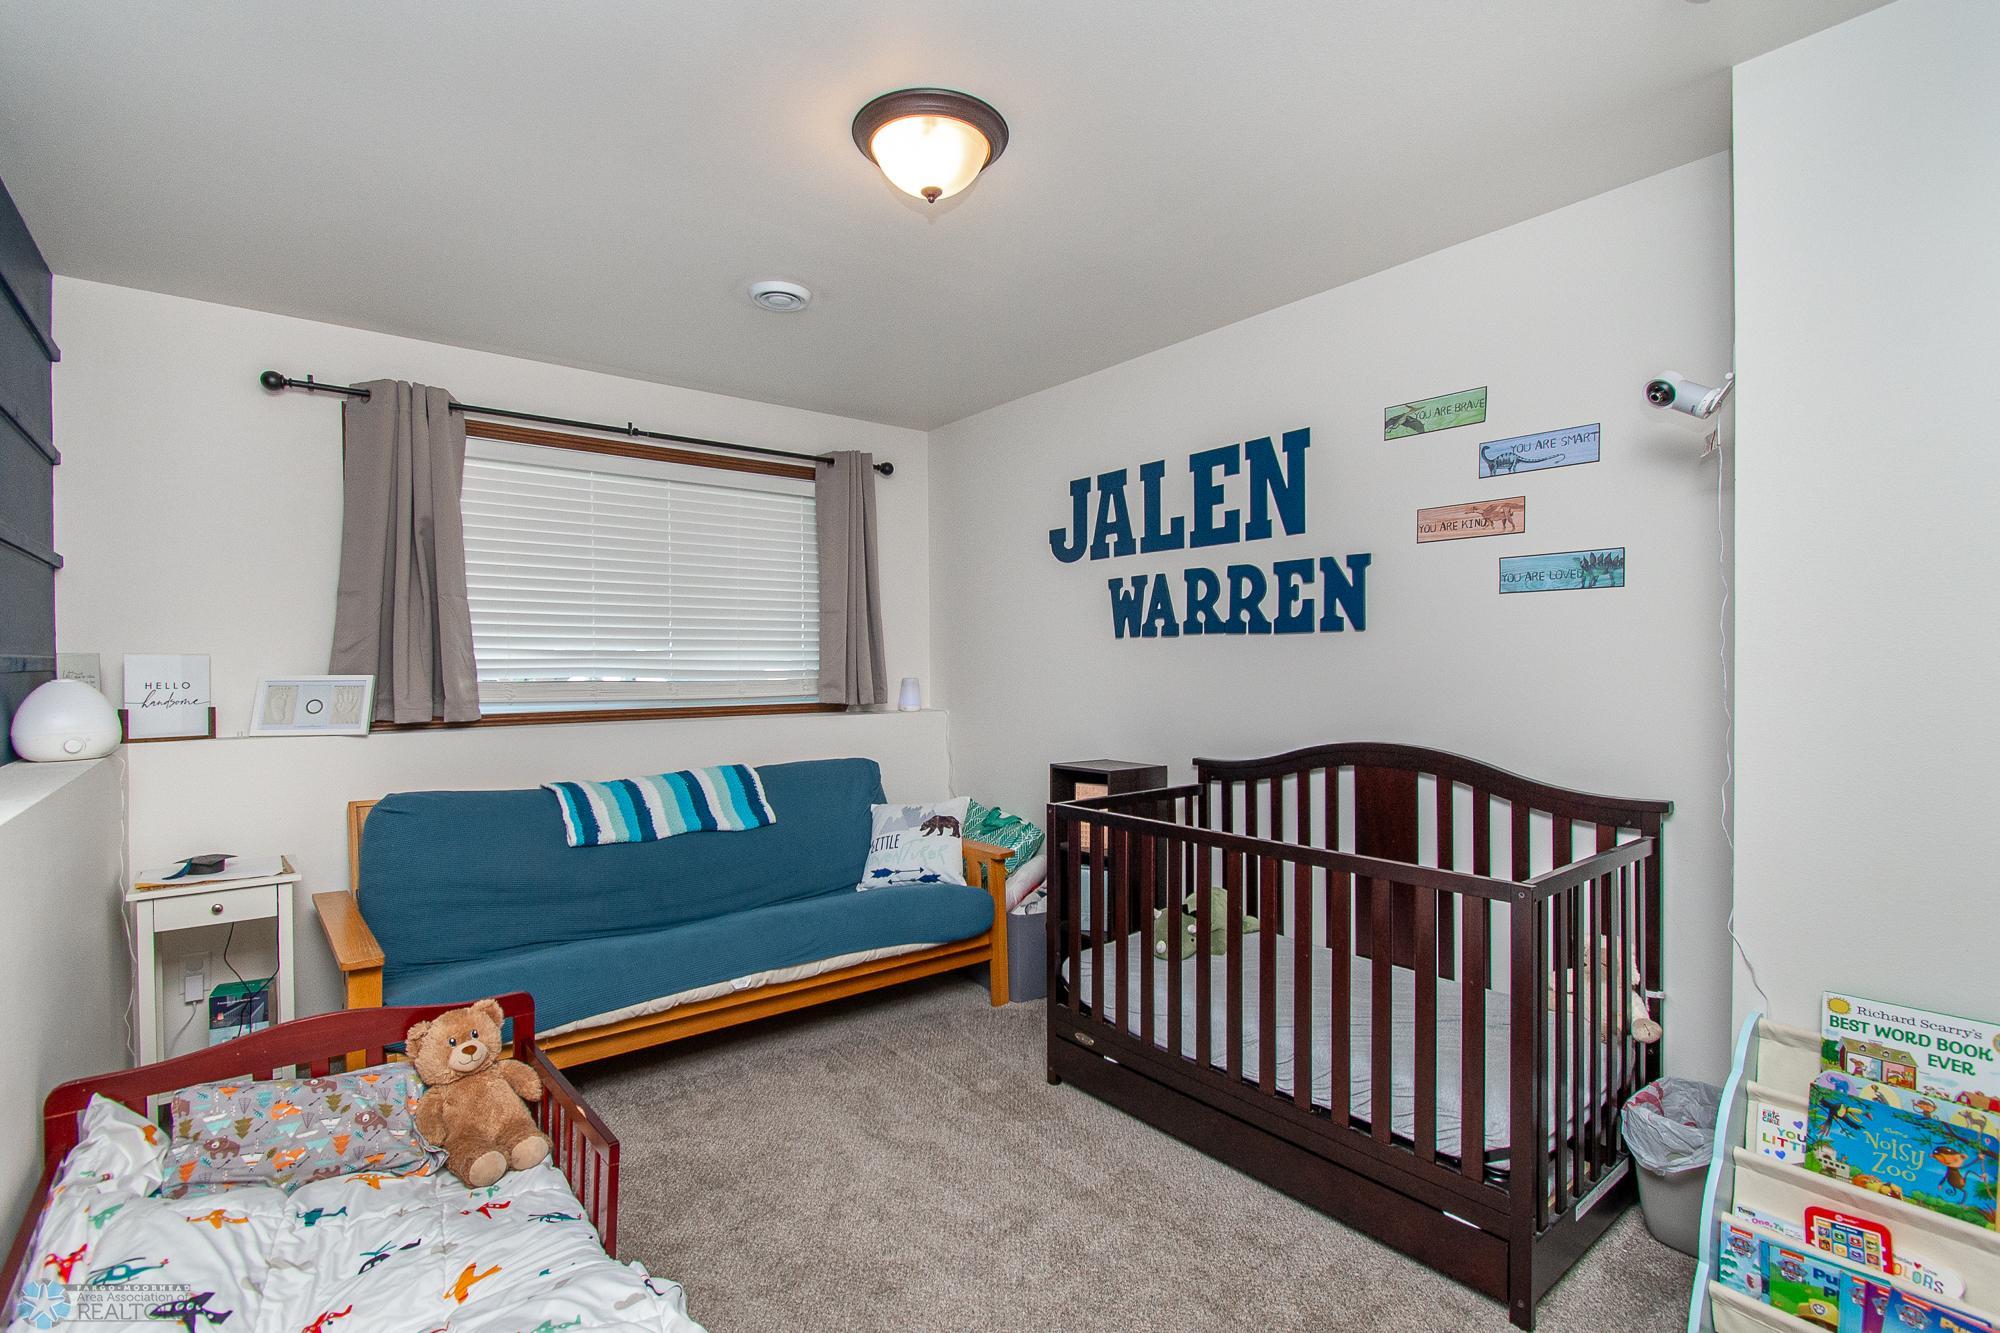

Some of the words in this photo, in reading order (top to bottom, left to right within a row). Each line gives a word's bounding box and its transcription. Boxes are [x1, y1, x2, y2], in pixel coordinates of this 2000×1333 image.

[1414, 410, 1432, 420] YOU
[1434, 406, 1452, 416] ARE
[1454, 399, 1485, 413] BRAVE
[1511, 443, 1532, 454] YOU
[1535, 438, 1557, 450] ARE
[1560, 432, 1599, 447] SMART
[1049, 427, 1311, 563] JALEN
[1419, 523, 1437, 533] YOU
[1440, 520, 1459, 531] ARE
[1501, 572, 1521, 583] YOU
[1524, 571, 1546, 582] ARE
[1549, 568, 1585, 580] LOVED
[1108, 552, 1371, 639] WARREN
[144, 681, 191, 690] HELLO
[141, 688, 199, 710] handsome
[871, 834, 900, 854] LITTLE
[1856, 1005, 1917, 1027] Richard
[1919, 1018, 1984, 1041] Scarry's
[1828, 1014, 1871, 1035] BEST
[1873, 1023, 1933, 1049] WORD
[1935, 1037, 1994, 1063] BOOK
[1926, 1053, 1977, 1077] EVER
[1893, 1262, 1944, 1295] OLORS
